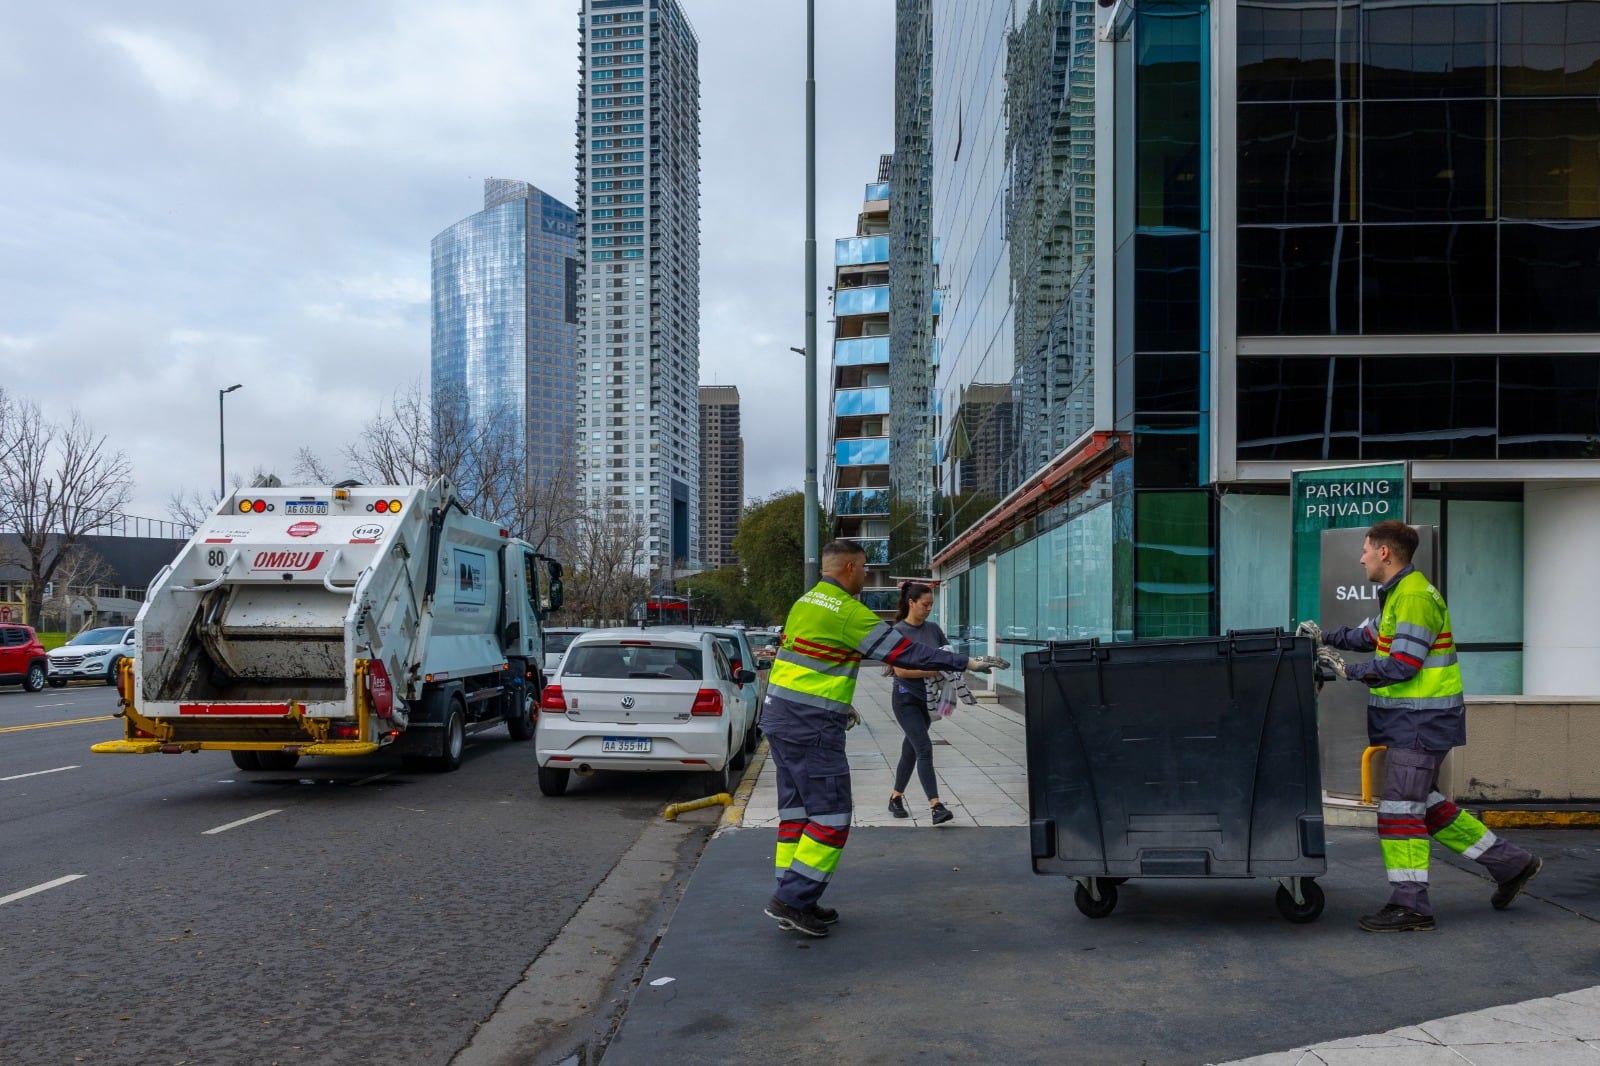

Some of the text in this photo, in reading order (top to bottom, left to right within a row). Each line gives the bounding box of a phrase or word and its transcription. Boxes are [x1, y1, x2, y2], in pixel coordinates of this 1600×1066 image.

[1306, 480, 1390, 499] PARKING
[287, 506, 297, 514] AG
[299, 506, 314, 514] 630
[1306, 500, 1389, 518] PRIVADO
[208, 550, 224, 567] 80
[253, 551, 310, 568] OMBU
[1336, 584, 1383, 601] SALI
[811, 599, 840, 613] URBANA
[604, 741, 616, 751] AA
[618, 741, 636, 751] 355
